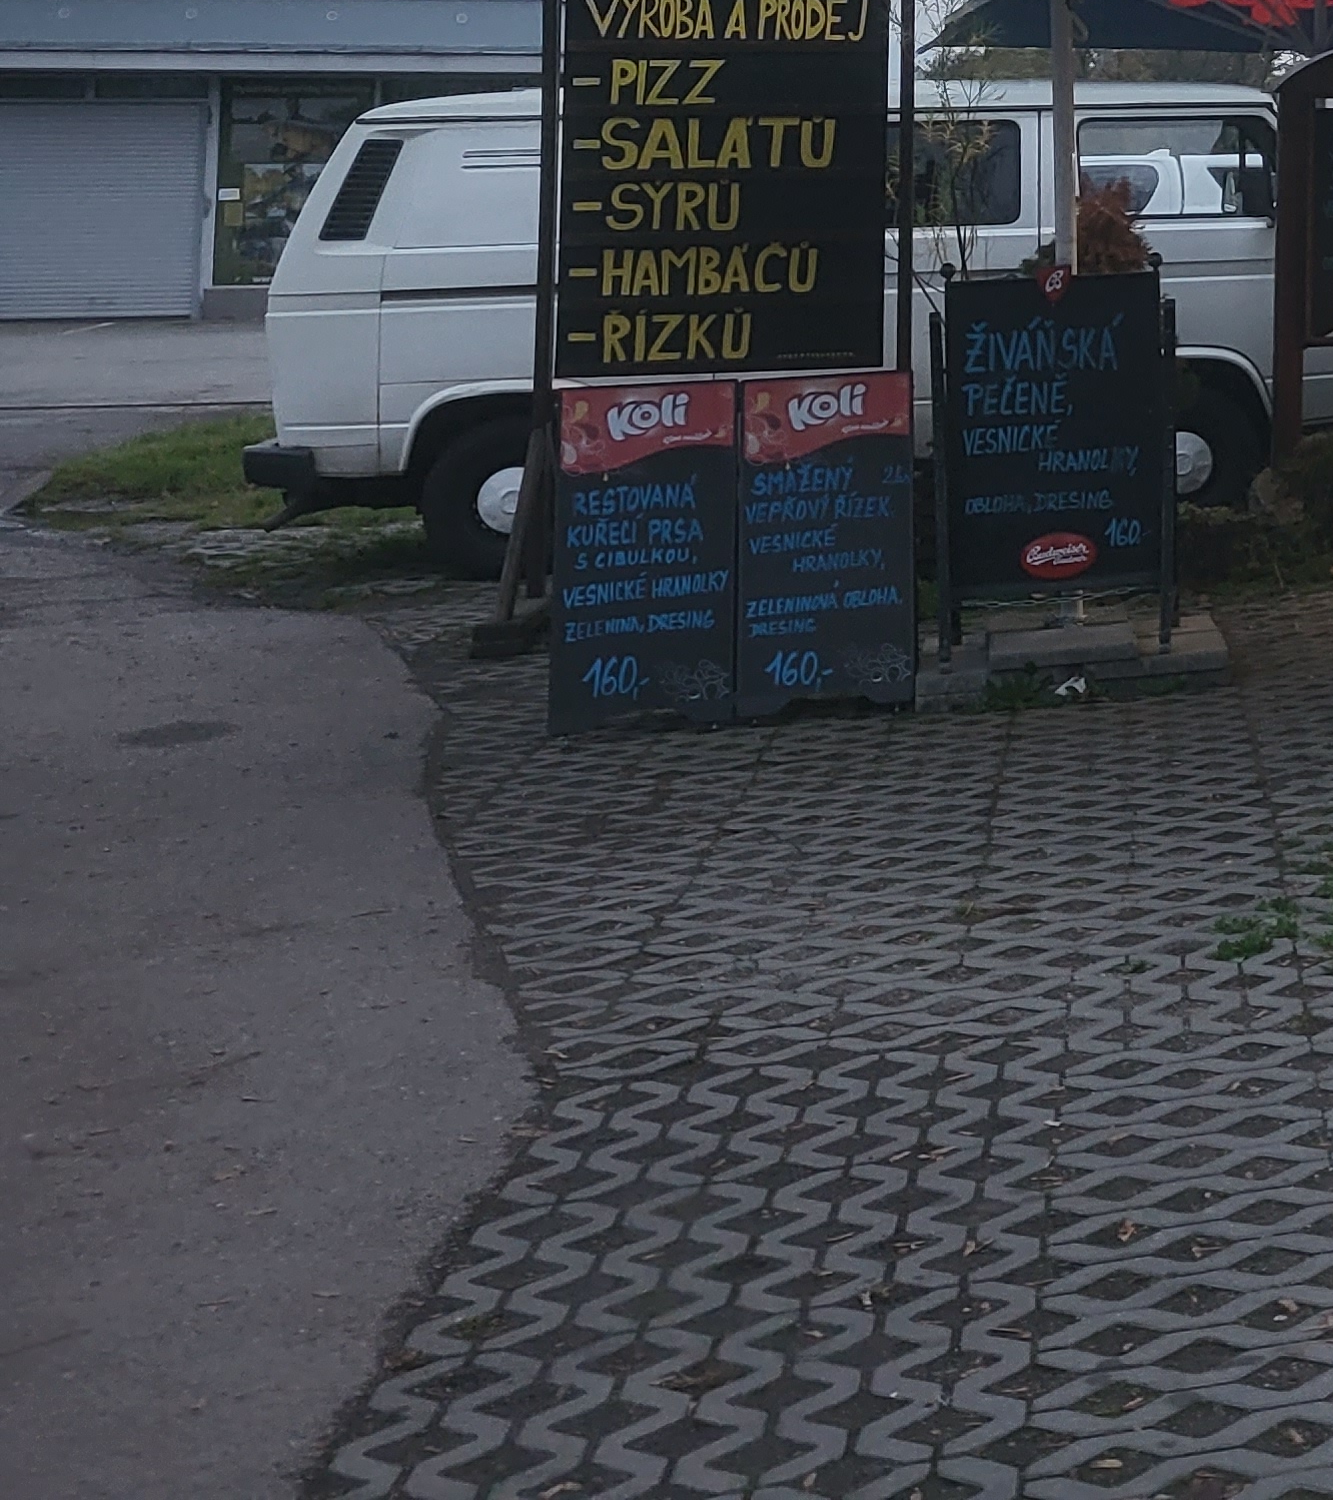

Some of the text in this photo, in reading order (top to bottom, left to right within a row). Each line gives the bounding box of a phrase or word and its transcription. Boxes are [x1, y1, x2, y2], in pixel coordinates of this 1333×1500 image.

[962, 418, 1062, 456] VESNICKÉ
[567, 512, 643, 548] KUŘECÍ
[749, 523, 839, 554] VESNICKÉ
[563, 569, 729, 609] VESNICKÉ HRANOLKY
[646, 609, 715, 633] DRESING
